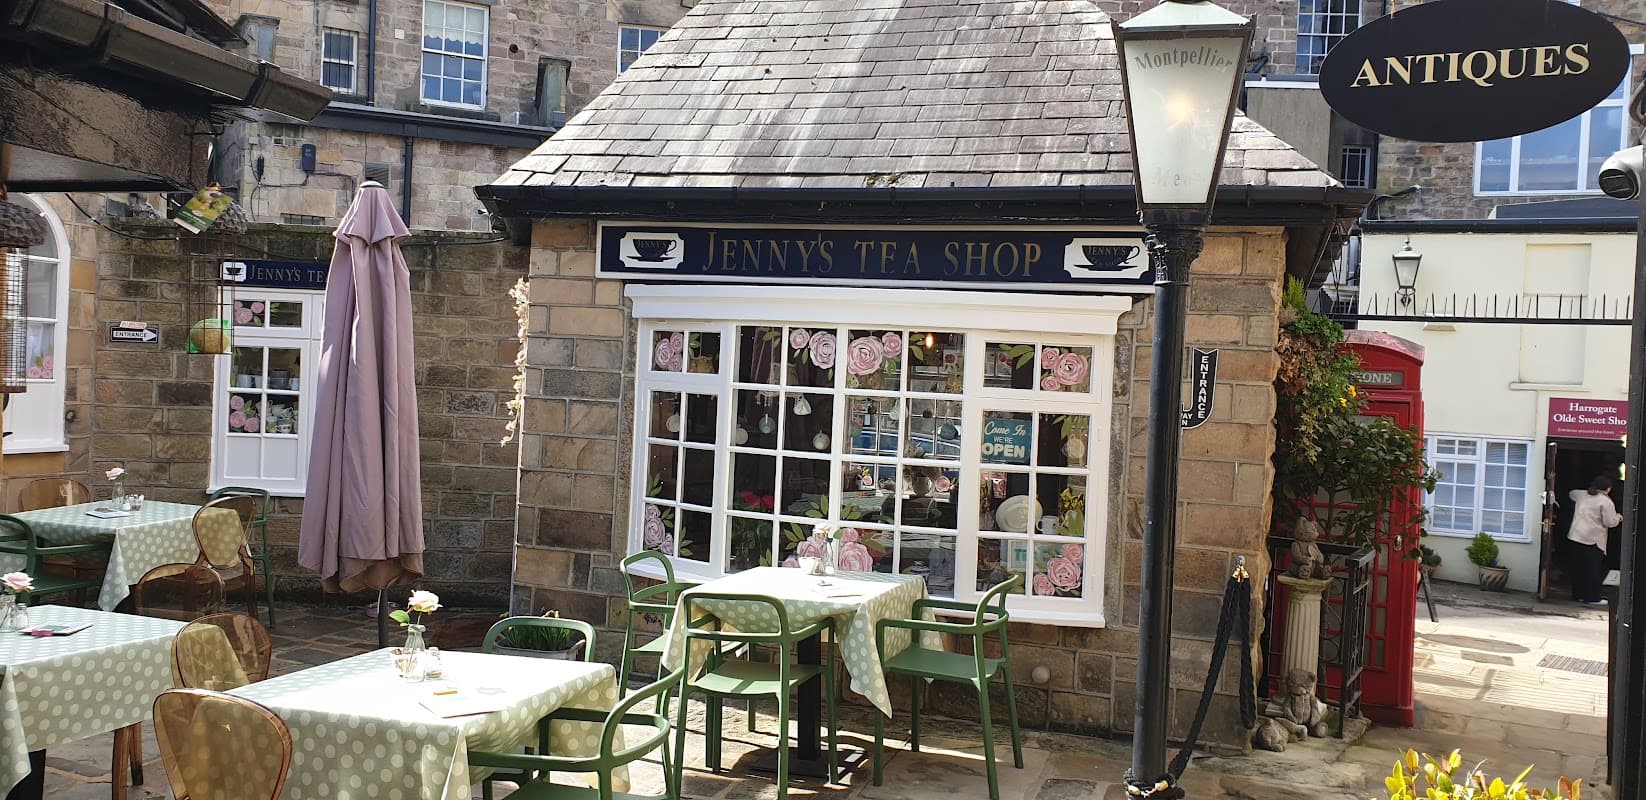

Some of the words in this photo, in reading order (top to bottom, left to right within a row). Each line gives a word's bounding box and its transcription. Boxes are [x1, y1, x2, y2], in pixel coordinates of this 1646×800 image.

[1135, 47, 1232, 71] Montpellier
[1350, 43, 1590, 87] ANTIQUES
[702, 232, 834, 272] JENNY'S
[854, 240, 921, 274] TEA
[943, 242, 1042, 277] SHOP
[249, 265, 300, 281] JENNY'S
[307, 270, 327, 283] TE
[1198, 356, 1209, 418] ENTRANCE
[1569, 402, 1617, 415] Harrogate
[1553, 413, 1576, 423] Olde
[1579, 414, 1606, 425] Sweet
[1608, 416, 1628, 426] Sho
[985, 421, 1010, 435] Come
[1012, 424, 1026, 436] In
[994, 436, 1013, 444] WE'RE
[982, 443, 1025, 458] OPEN
